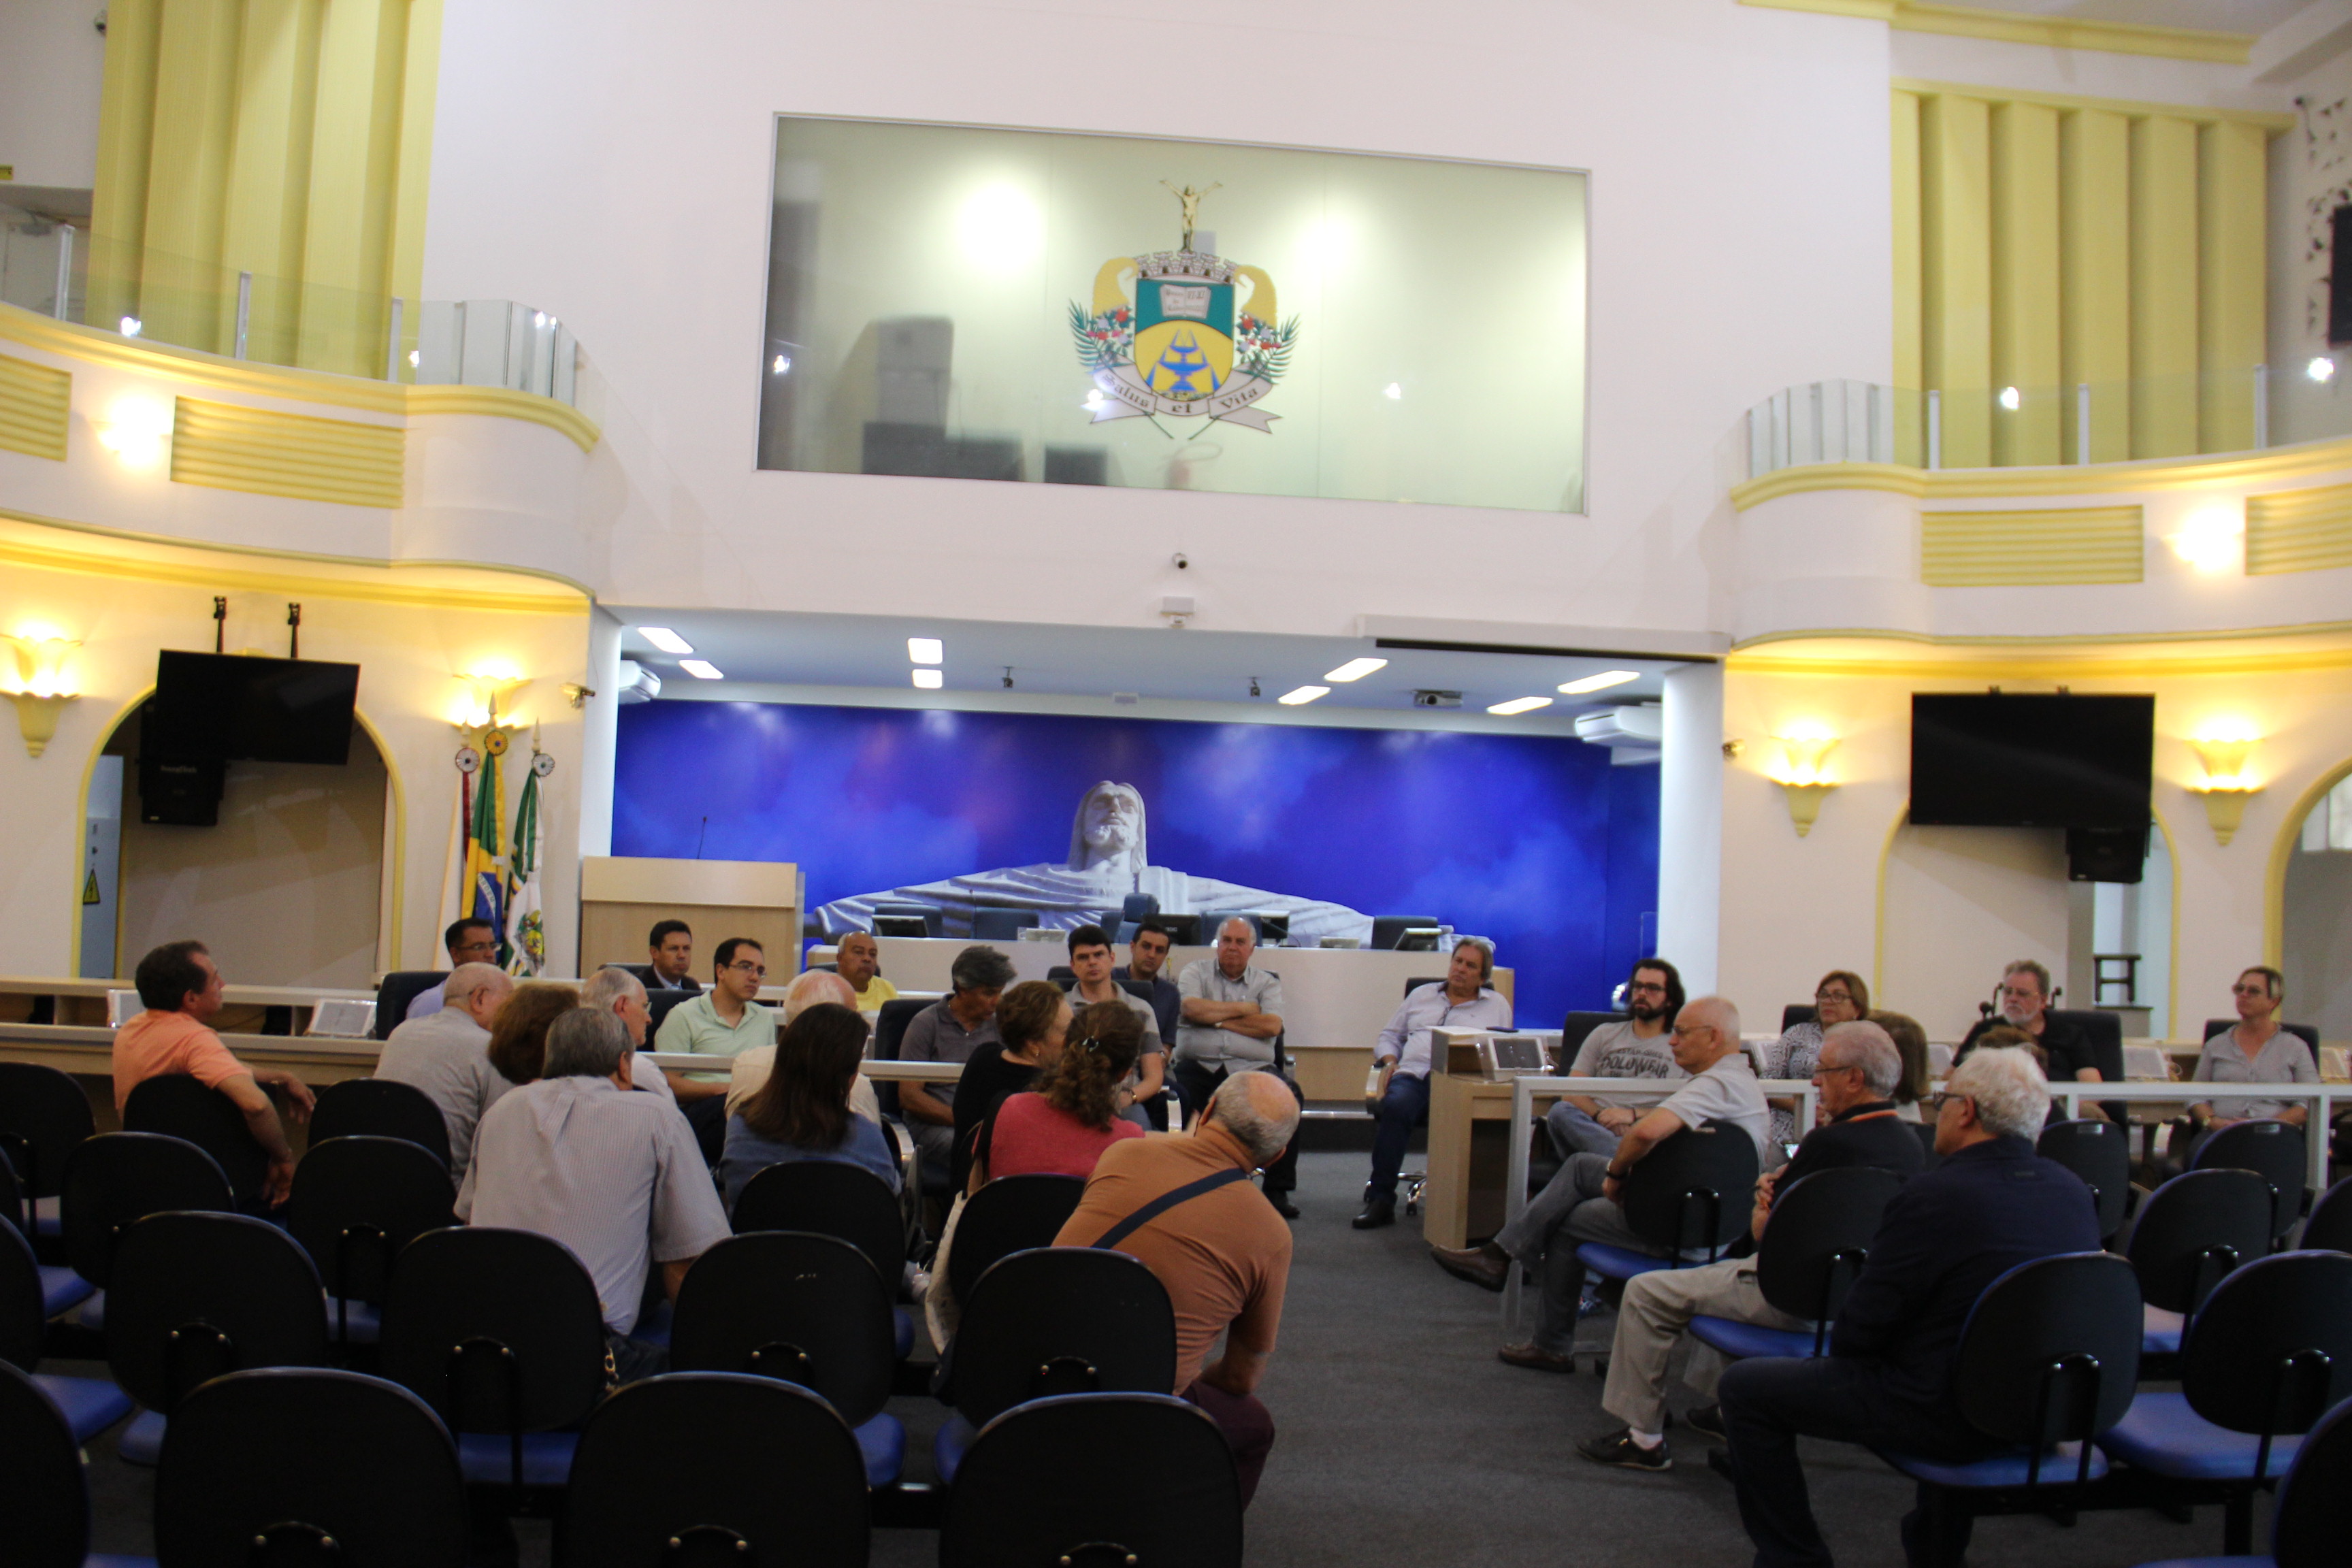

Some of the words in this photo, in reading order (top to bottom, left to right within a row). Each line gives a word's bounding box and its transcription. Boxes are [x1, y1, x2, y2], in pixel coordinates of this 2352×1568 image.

[1102, 374, 1149, 408] Salus
[1171, 403, 1192, 413] et
[1219, 387, 1258, 409] Vita
